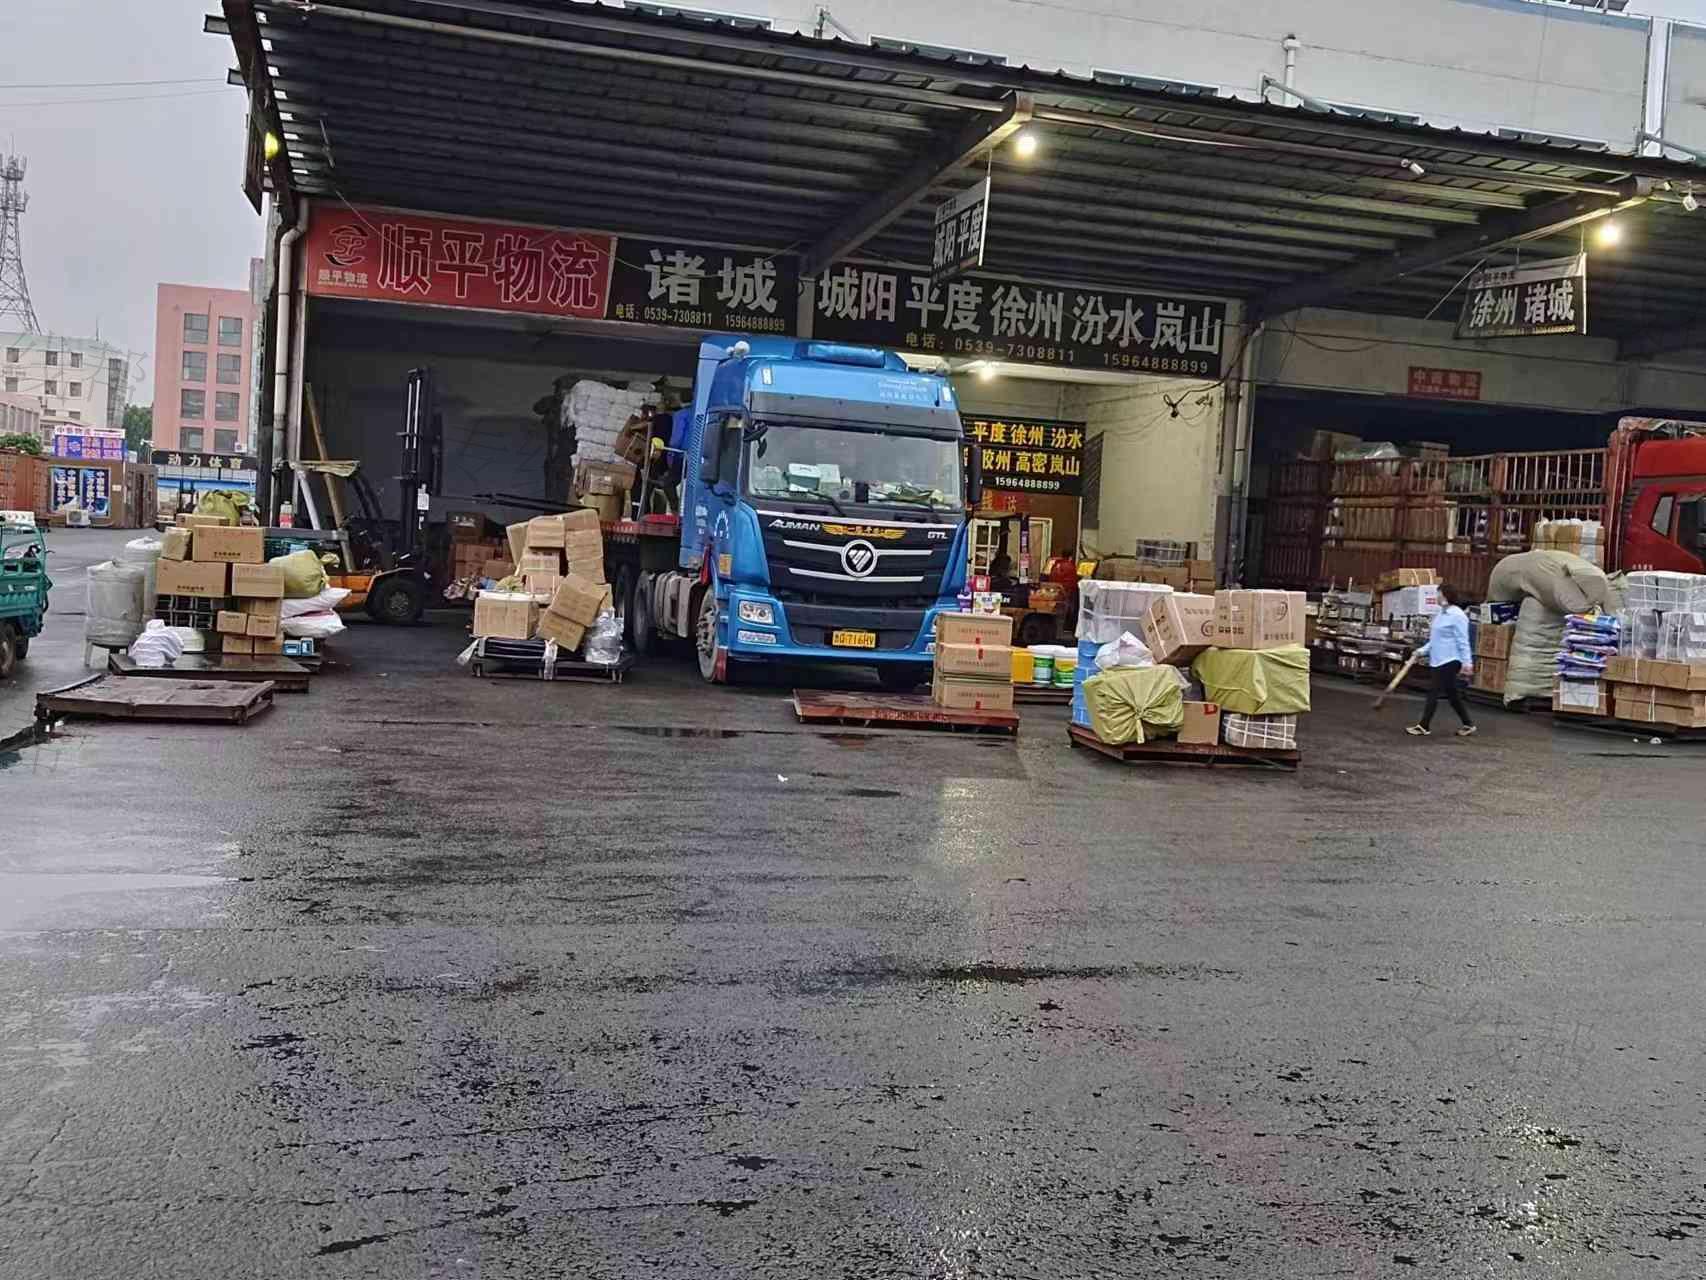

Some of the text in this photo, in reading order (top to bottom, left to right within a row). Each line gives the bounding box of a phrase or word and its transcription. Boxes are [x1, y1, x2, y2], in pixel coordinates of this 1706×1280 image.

[376, 222, 600, 309] 顺平物流
[643, 248, 778, 315] 诸城
[1102, 352, 1209, 375] 15964888899
[168, 453, 243, 469] 动力体育
[994, 476, 1060, 490] 15964888899
[927, 531, 949, 540] GTL
